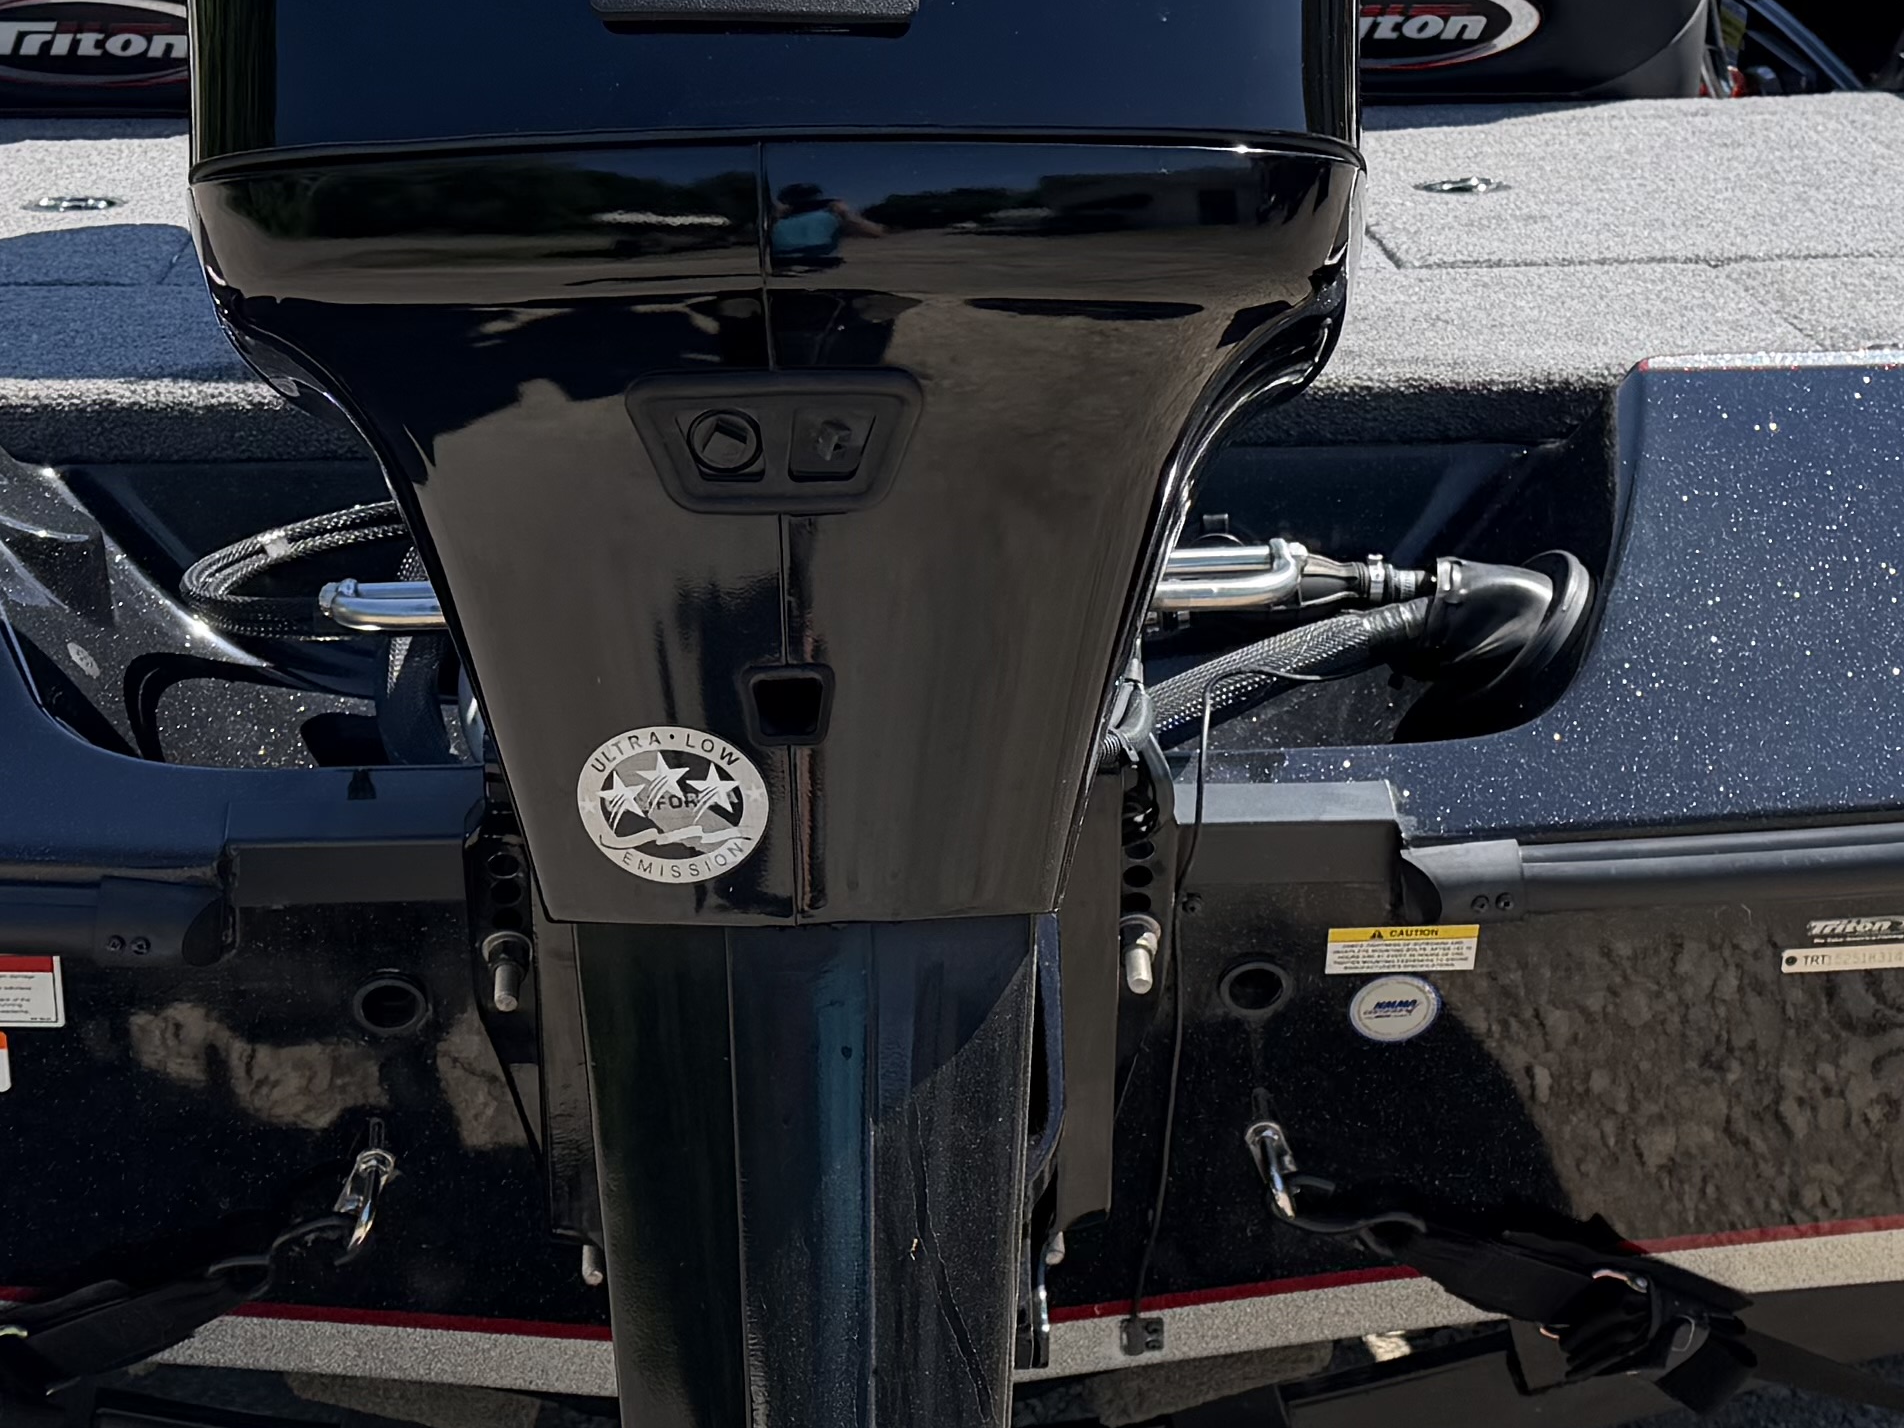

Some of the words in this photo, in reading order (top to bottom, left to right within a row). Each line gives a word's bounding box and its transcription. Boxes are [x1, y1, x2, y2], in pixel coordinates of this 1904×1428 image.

[590, 731, 661, 773] ULTRA
[686, 733, 740, 766] LOW
[622, 842, 744, 879] EMISSION
[1390, 929, 1438, 937] CAUTION
[1807, 920, 1893, 935] Triton
